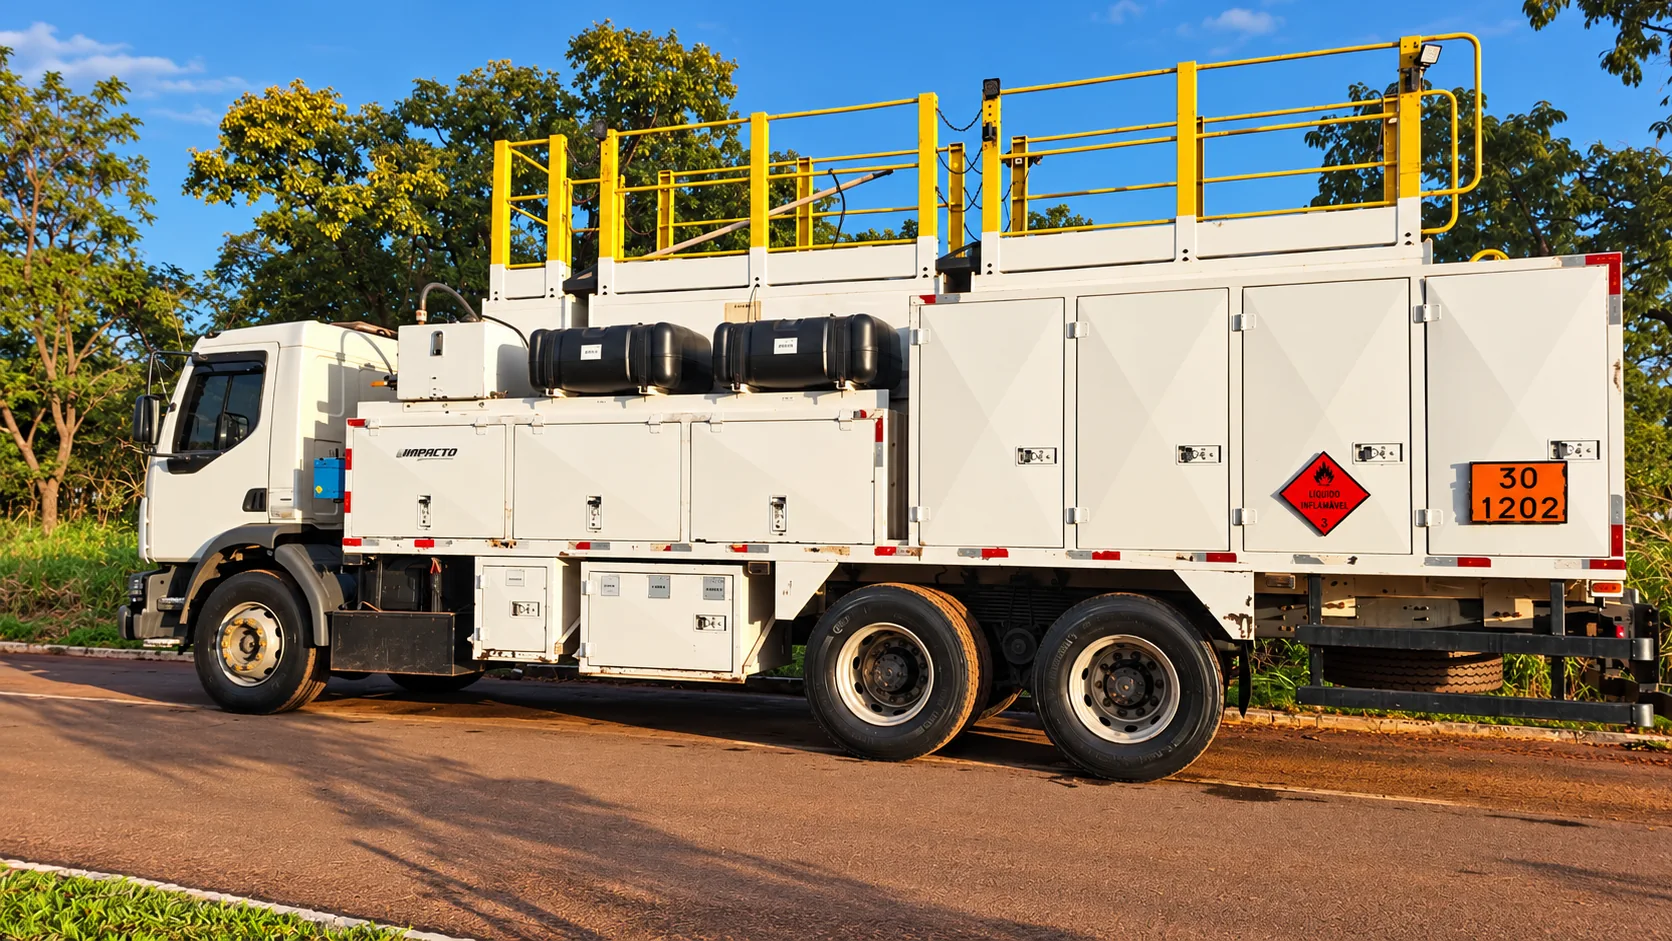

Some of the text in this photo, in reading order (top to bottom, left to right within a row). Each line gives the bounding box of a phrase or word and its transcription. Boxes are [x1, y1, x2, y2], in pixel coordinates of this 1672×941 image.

[401, 448, 458, 458] IMPACTO
[1499, 467, 1538, 489] 30
[1300, 500, 1348, 510] INFLAMÁVEL
[1482, 496, 1559, 519] 1202
[1320, 518, 1328, 528] 3
